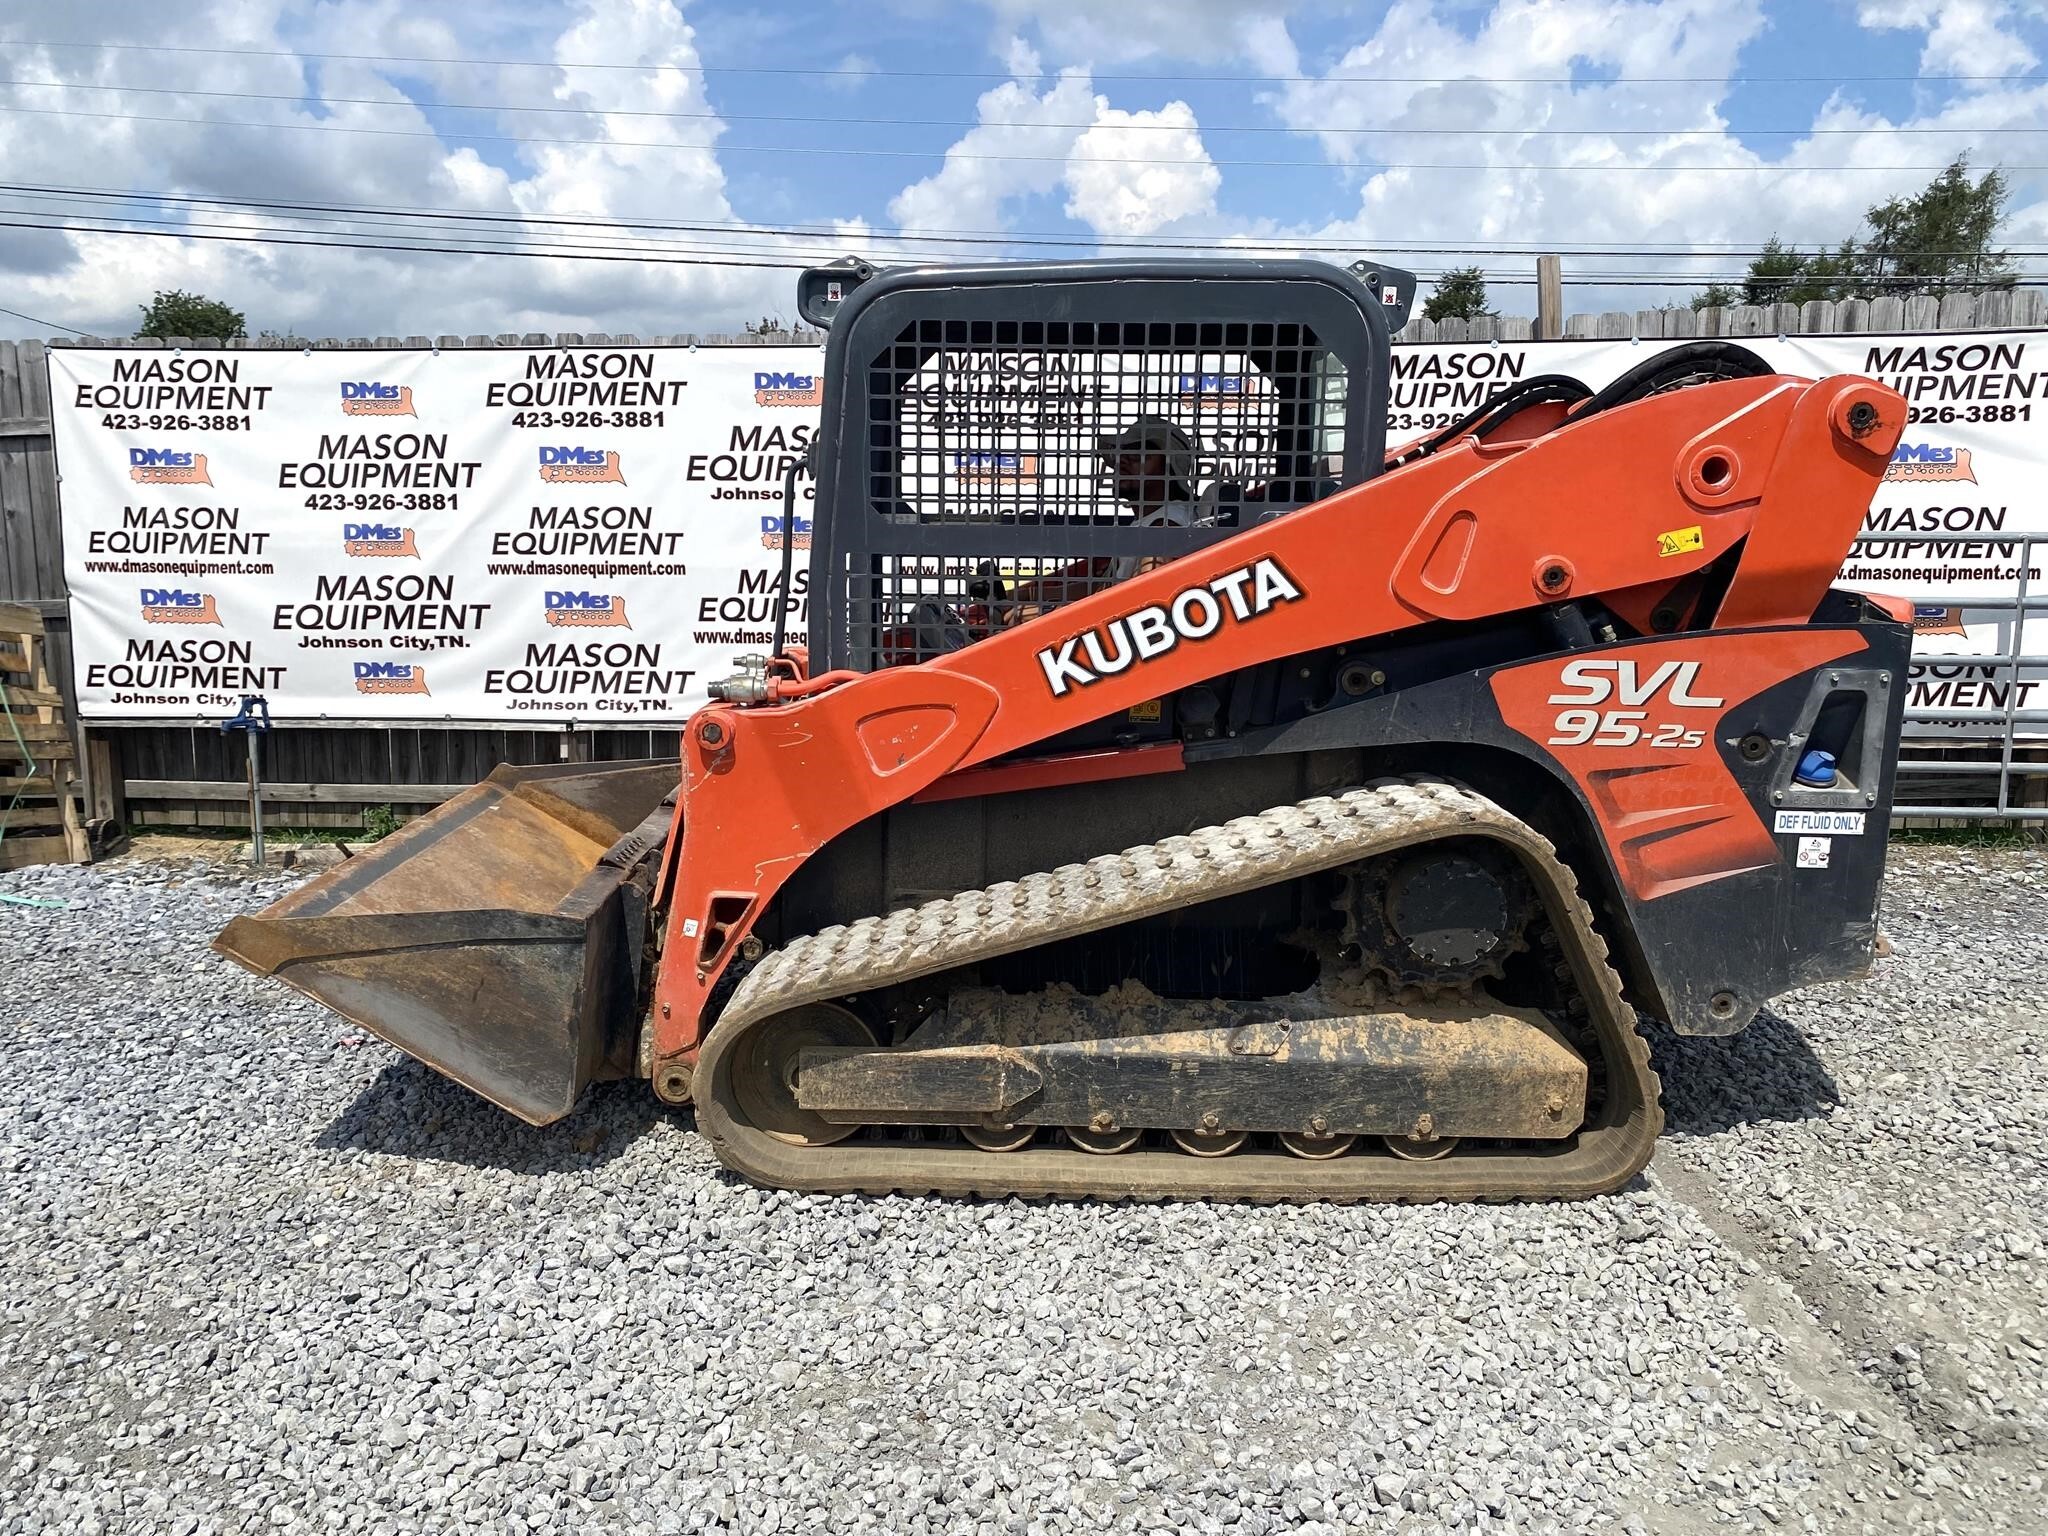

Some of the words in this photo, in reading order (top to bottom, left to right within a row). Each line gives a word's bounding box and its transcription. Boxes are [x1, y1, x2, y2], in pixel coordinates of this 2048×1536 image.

[526, 354, 654, 379] MASON
[1390, 352, 1525, 379] MASON
[1864, 344, 2025, 372] MASON
[112, 359, 239, 382] MASON
[75, 385, 272, 410] EQUIPMENT
[486, 381, 687, 408] EQUIPMENT
[102, 414, 251, 431] 423-926-3881
[512, 411, 664, 428] 423-926-3881
[318, 434, 448, 460] MASON
[278, 463, 482, 488] EQUIPMENT
[305, 494, 458, 510] 423-926-3881
[710, 487, 796, 500] Johnso
[122, 506, 239, 529] MASON
[529, 506, 652, 529] MASON
[1860, 506, 2007, 532] MASON
[88, 531, 270, 555] EQUIPMENT
[492, 532, 683, 555] EQUIPMENT
[85, 559, 274, 577] www.dmasonequipment.com
[488, 561, 686, 578] www.dmasonequipment.com
[315, 575, 454, 601] MASON
[273, 604, 491, 630] EQUIPMENT
[1039, 557, 1301, 696] KUBOTA
[298, 636, 383, 648] Johnson
[390, 636, 471, 650] City,TN.
[693, 628, 807, 646] www.dmasneq
[125, 639, 252, 664] MASON
[525, 643, 661, 667] MASON
[86, 664, 287, 690] EQUIPMENT
[484, 670, 696, 694] EQUIPMENT
[1547, 660, 1725, 708] SVL
[110, 692, 190, 704] Johnson
[506, 699, 589, 711] Johnson
[595, 700, 673, 713] City,TN.
[1779, 815, 1800, 828] DEF
[1801, 816, 1831, 830] FLUID
[1834, 816, 1861, 830] ONLY
